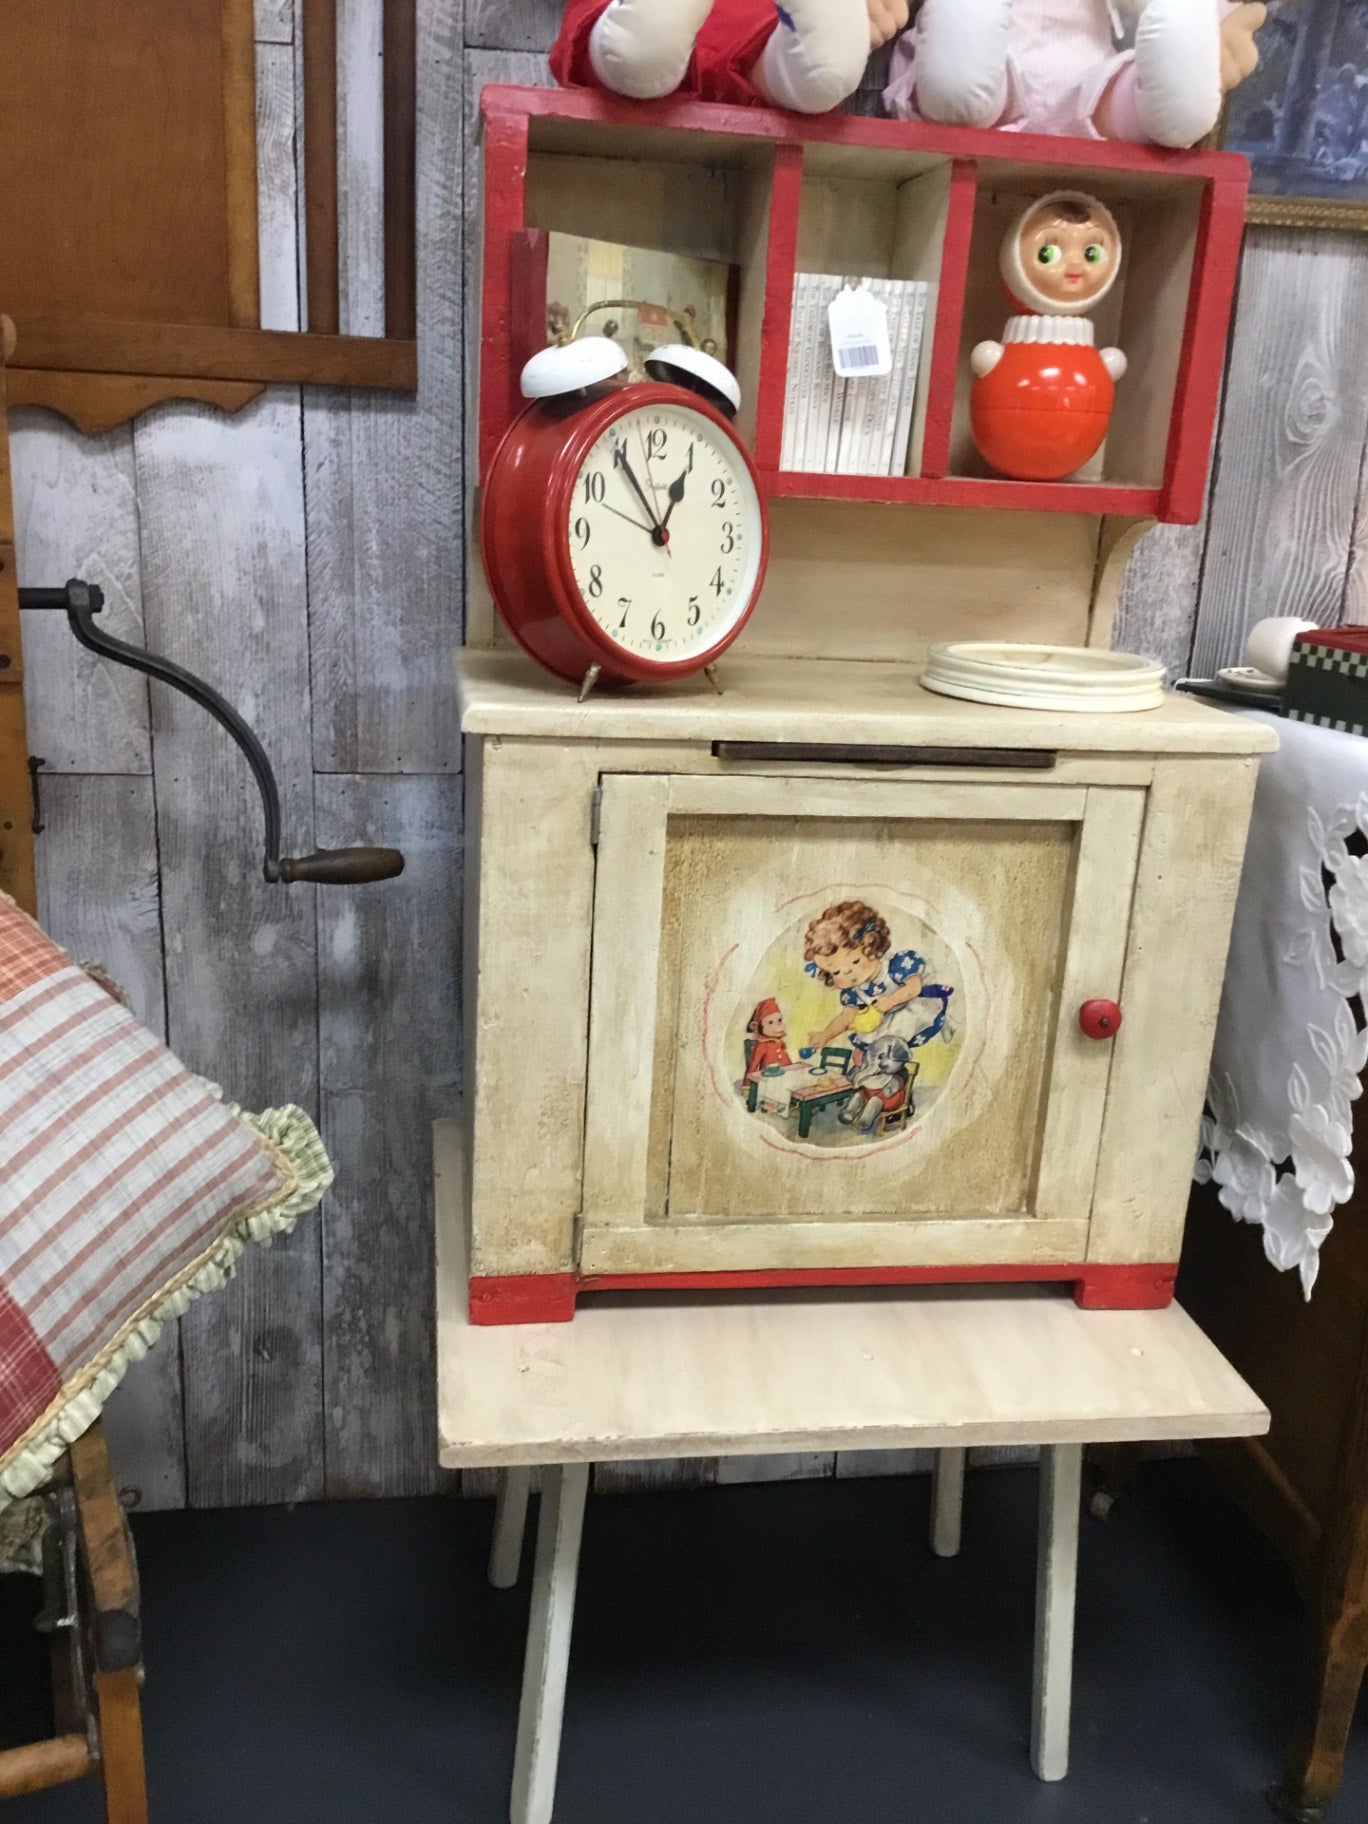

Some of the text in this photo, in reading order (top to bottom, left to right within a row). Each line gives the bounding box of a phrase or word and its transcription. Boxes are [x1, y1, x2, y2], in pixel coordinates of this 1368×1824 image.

[644, 428, 667, 461] 12
[685, 441, 694, 474] 1
[584, 471, 606, 505] 10
[711, 478, 726, 508] 2
[574, 517, 591, 551] 9
[720, 521, 735, 554] 3
[588, 564, 603, 597] 8
[709, 565, 725, 597] 4
[617, 597, 632, 628] 7
[651, 609, 666, 641] 6
[687, 595, 700, 626] 5
